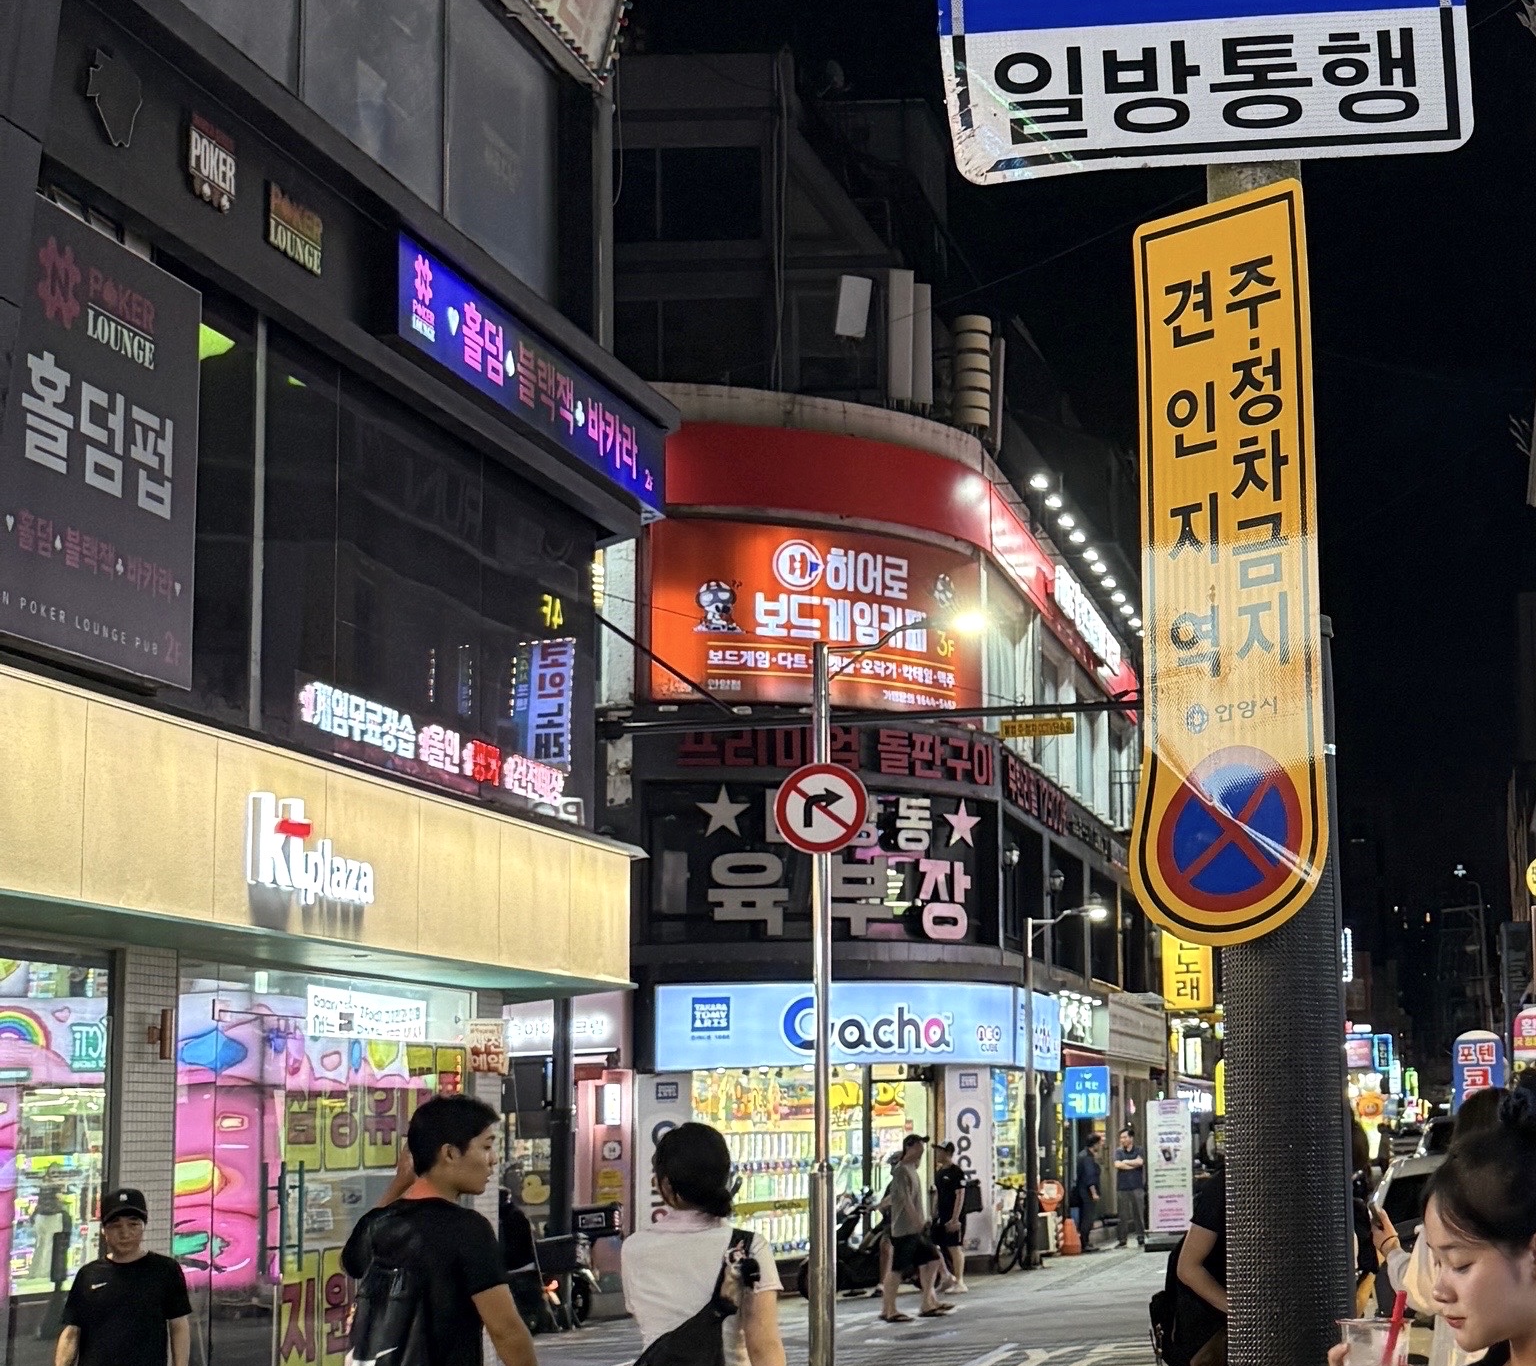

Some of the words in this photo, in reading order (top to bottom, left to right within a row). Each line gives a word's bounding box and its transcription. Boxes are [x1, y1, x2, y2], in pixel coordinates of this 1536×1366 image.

[994, 27, 1421, 145] 일방통행
[190, 127, 236, 197] POKER
[269, 218, 322, 276] LOUNGE
[86, 308, 155, 371] LOUNGE
[462, 300, 504, 387] 홀덤
[516, 339, 574, 436] 블랙잭
[587, 396, 639, 480] 바카라
[21, 349, 174, 521] 홀덤펍
[1163, 270, 1223, 678] 견인지역
[825, 546, 909, 602] 히어로
[20, 596, 66, 624] POKER
[74, 614, 127, 646] LOUNGE
[134, 636, 159, 656] PUB
[1214, 695, 1279, 726] 안양시
[877, 728, 994, 786] 돌판구이
[300, 838, 375, 905] plaza
[1174, 942, 1202, 1002] 노래
